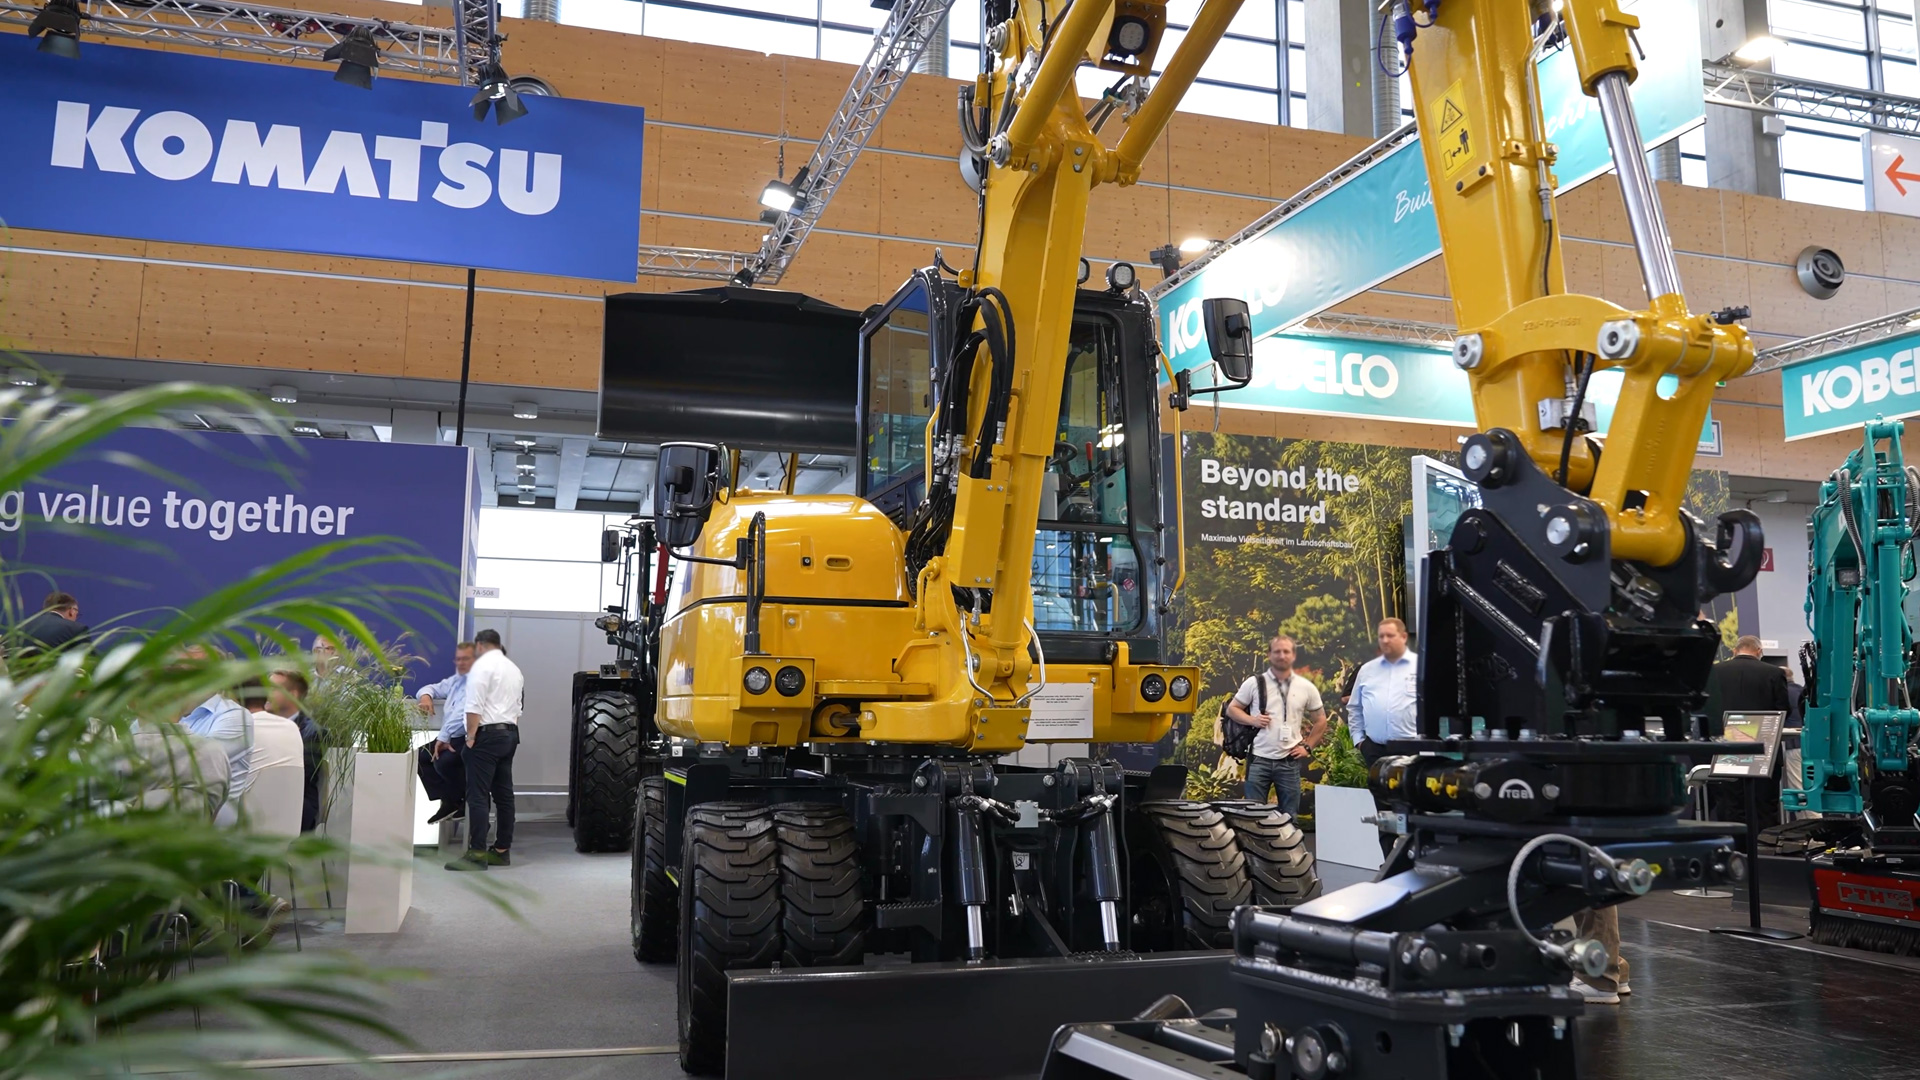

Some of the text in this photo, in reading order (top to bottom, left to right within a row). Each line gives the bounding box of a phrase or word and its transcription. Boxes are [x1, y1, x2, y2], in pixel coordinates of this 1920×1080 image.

[51, 101, 562, 215] KOMATSU
[1201, 458, 1360, 492] Beyond the
[38, 484, 151, 527] value
[163, 491, 354, 541] together
[1201, 495, 1326, 524] standard
[1201, 533, 1237, 543] Maximale
[1841, 886, 1885, 904] PTH
